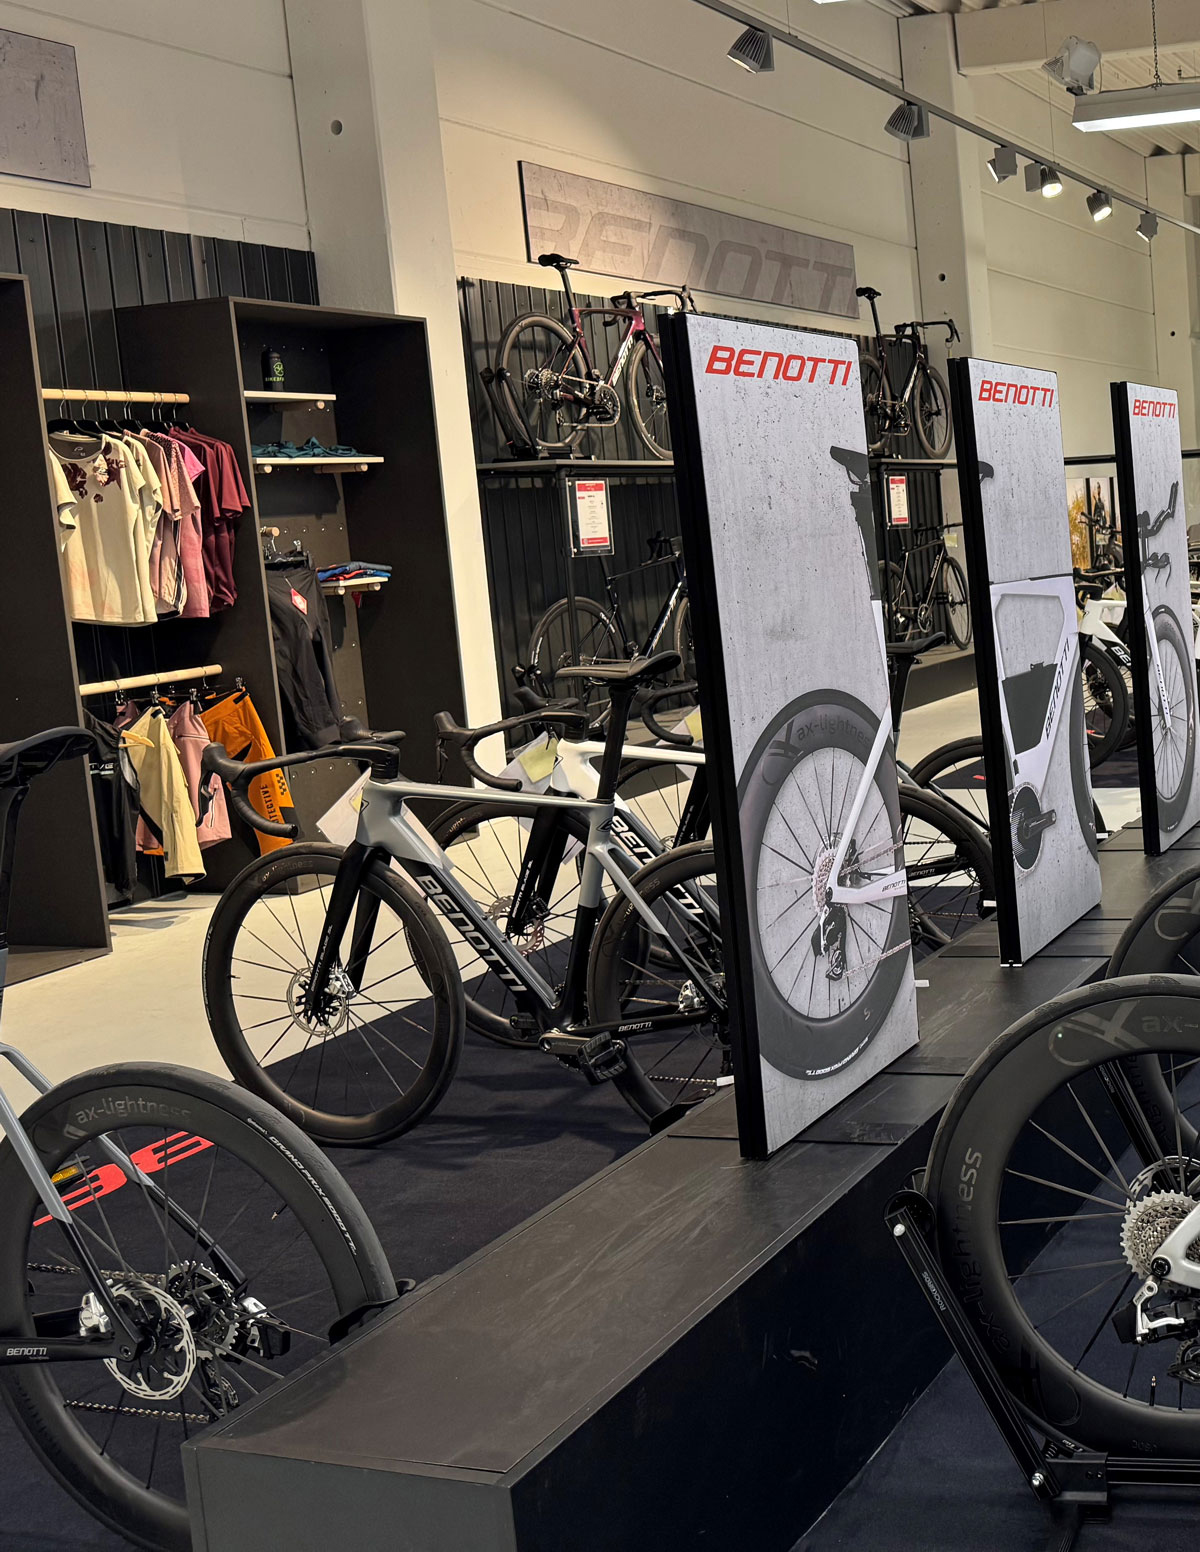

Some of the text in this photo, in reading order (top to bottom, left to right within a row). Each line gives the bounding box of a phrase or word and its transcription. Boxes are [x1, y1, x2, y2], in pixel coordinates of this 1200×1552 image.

[705, 345, 852, 386] BENOTTI
[978, 379, 1054, 408] BENOTTI
[1133, 399, 1176, 419] BENOTTI
[1045, 638, 1070, 741] BENOTTI
[416, 875, 526, 991] BENOTTI
[269, 1136, 305, 1170] GRAND
[301, 1168, 325, 1197] PRIX
[322, 1196, 347, 1232] 5000
[6, 1347, 48, 1356] BENOTTI
